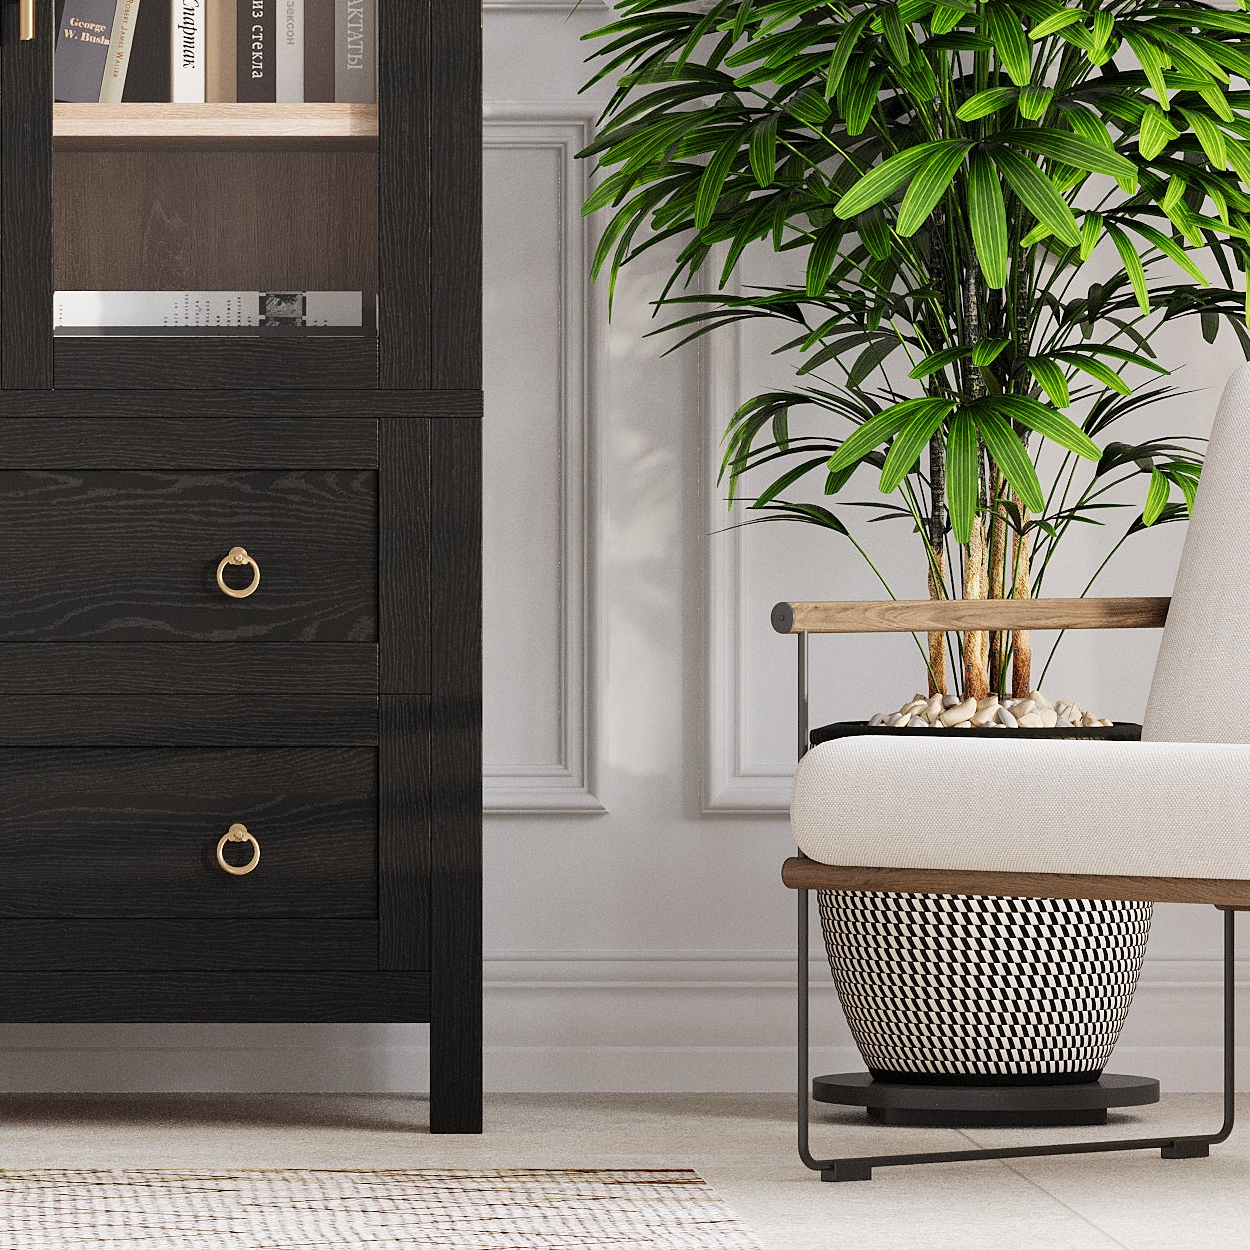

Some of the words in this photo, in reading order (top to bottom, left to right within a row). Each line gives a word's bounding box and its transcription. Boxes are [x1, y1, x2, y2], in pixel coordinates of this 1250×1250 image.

[252, 0, 264, 18] из
[69, 17, 106, 33] George
[64, 29, 77, 39] W.
[81, 33, 110, 45] Bush
[252, 25, 265, 79] стекла
